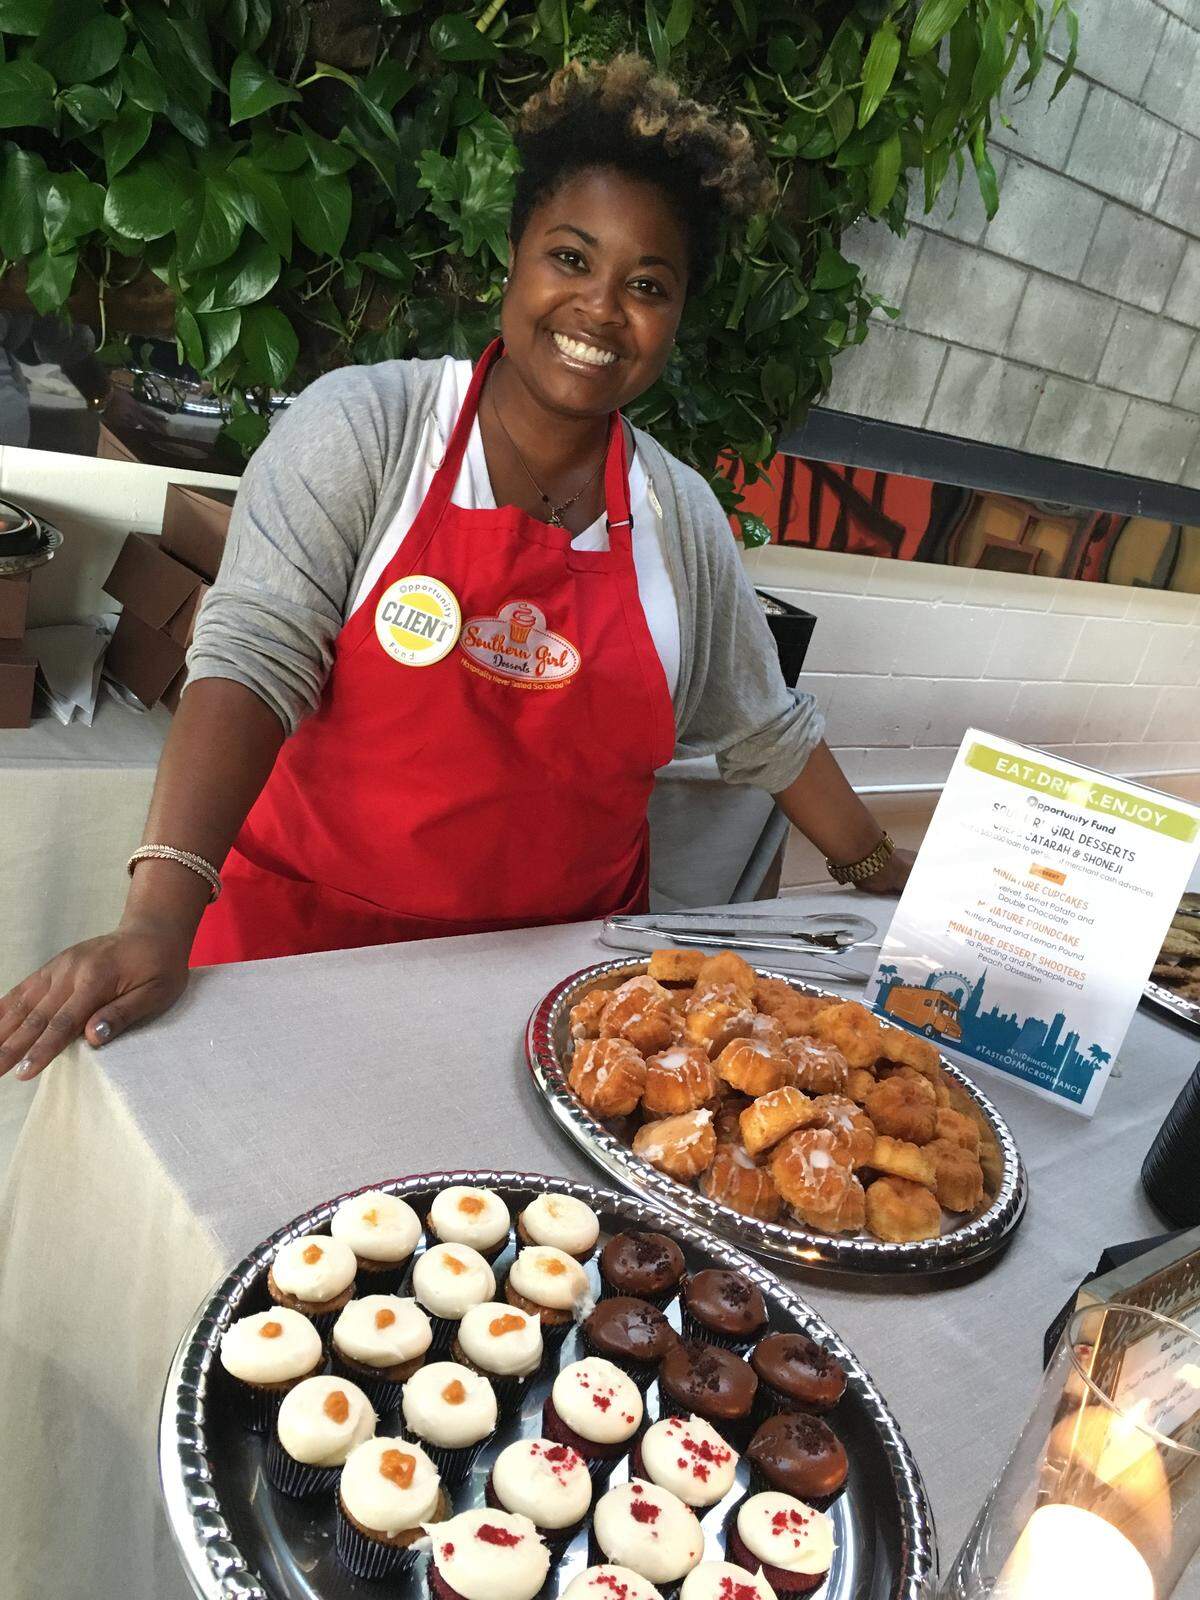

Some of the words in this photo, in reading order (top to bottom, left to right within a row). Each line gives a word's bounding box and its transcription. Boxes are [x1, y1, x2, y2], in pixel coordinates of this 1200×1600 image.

[400, 584, 451, 617] Opportunity
[381, 601, 453, 643] CLIENT
[388, 642, 416, 660] Fund
[466, 626, 531, 659] Southern
[535, 644, 569, 677] Girl
[493, 654, 530, 674] Desserts
[492, 675, 511, 687] Never
[533, 682, 543, 690] So
[1026, 795, 1089, 825] Opportunity
[1090, 820, 1115, 834] Fund
[1072, 849, 1080, 858] &
[1082, 852, 1122, 873] SHONEJI
[1078, 833, 1135, 862] DESSERTS
[997, 894, 1025, 909] Double
[1027, 904, 1068, 925] Chocolate
[1041, 886, 1089, 910] CUPCAKES
[1049, 904, 1075, 917] Potato
[1077, 914, 1093, 925] and
[949, 922, 995, 944] MINIATURE
[997, 940, 1035, 960] DESSERT
[1038, 956, 1086, 980] SHOOTERS
[987, 918, 1011, 932] Pound
[1013, 929, 1028, 939] and
[1030, 935, 1057, 950] Lemon
[1058, 946, 1084, 961] Pound
[975, 943, 1007, 961] Pudding
[1009, 956, 1024, 966] and
[1025, 962, 1065, 982] Pineapple
[1067, 978, 1083, 989] and
[978, 954, 1002, 967] Peach
[1003, 964, 1042, 983] Obsession
